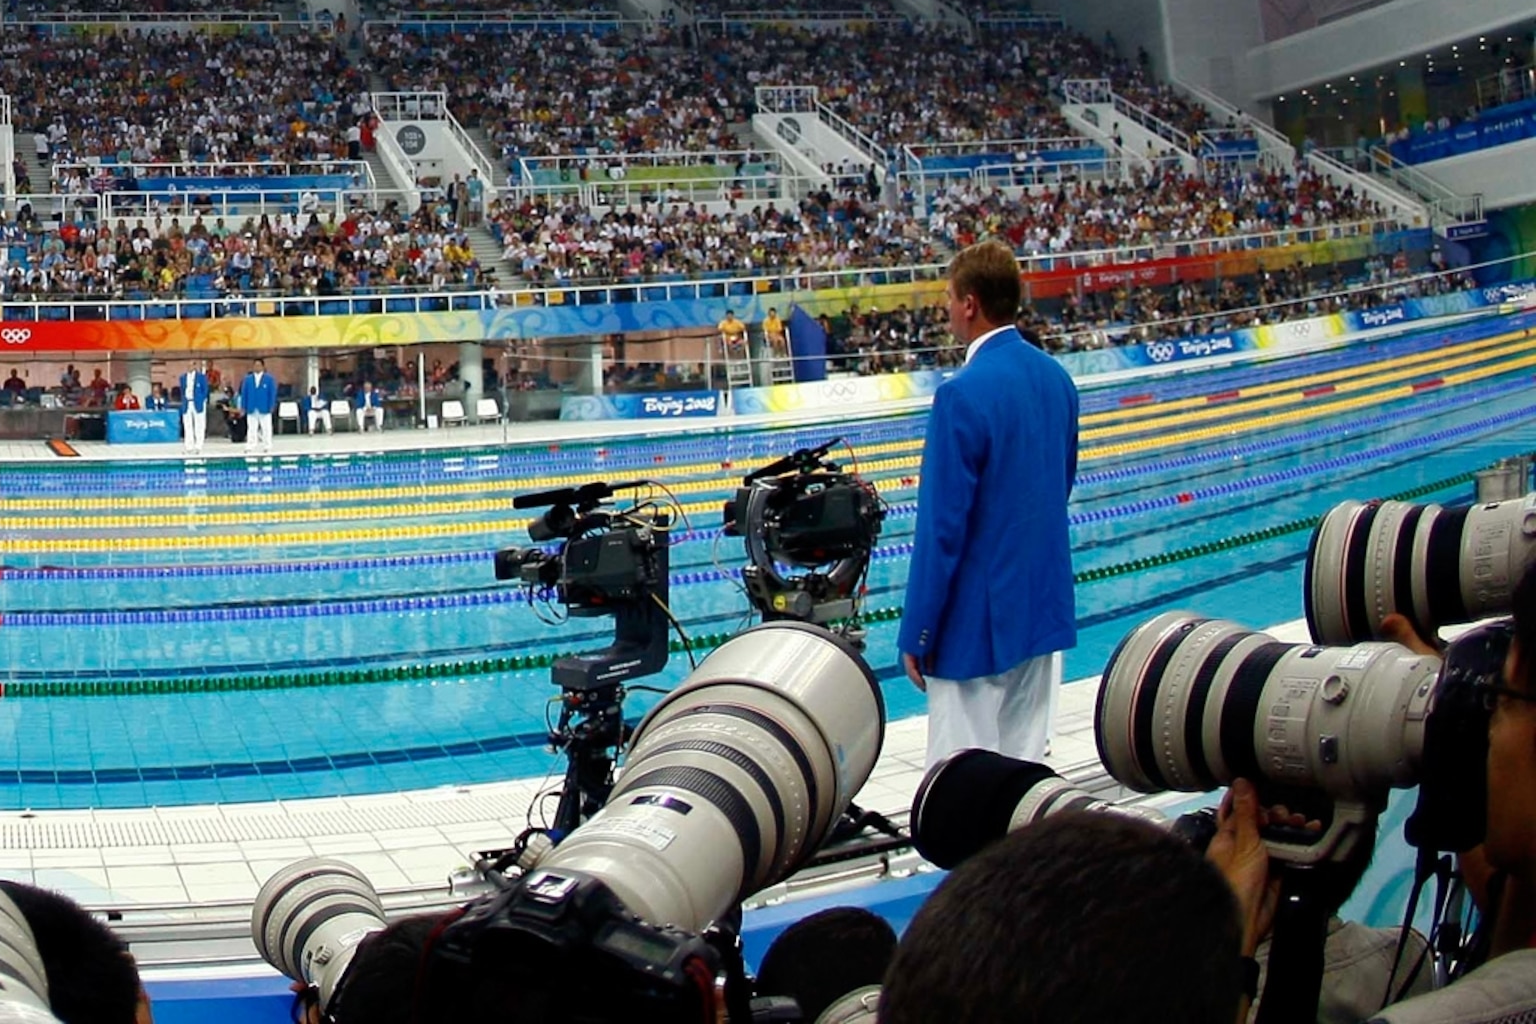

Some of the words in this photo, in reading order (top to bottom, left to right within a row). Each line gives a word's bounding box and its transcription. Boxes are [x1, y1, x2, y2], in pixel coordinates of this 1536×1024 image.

[1361, 311, 1386, 325] Beijing
[1178, 338, 1211, 356] Beijing
[1210, 337, 1233, 350] 2008
[642, 396, 683, 415] Beijing
[684, 396, 715, 411] 2008
